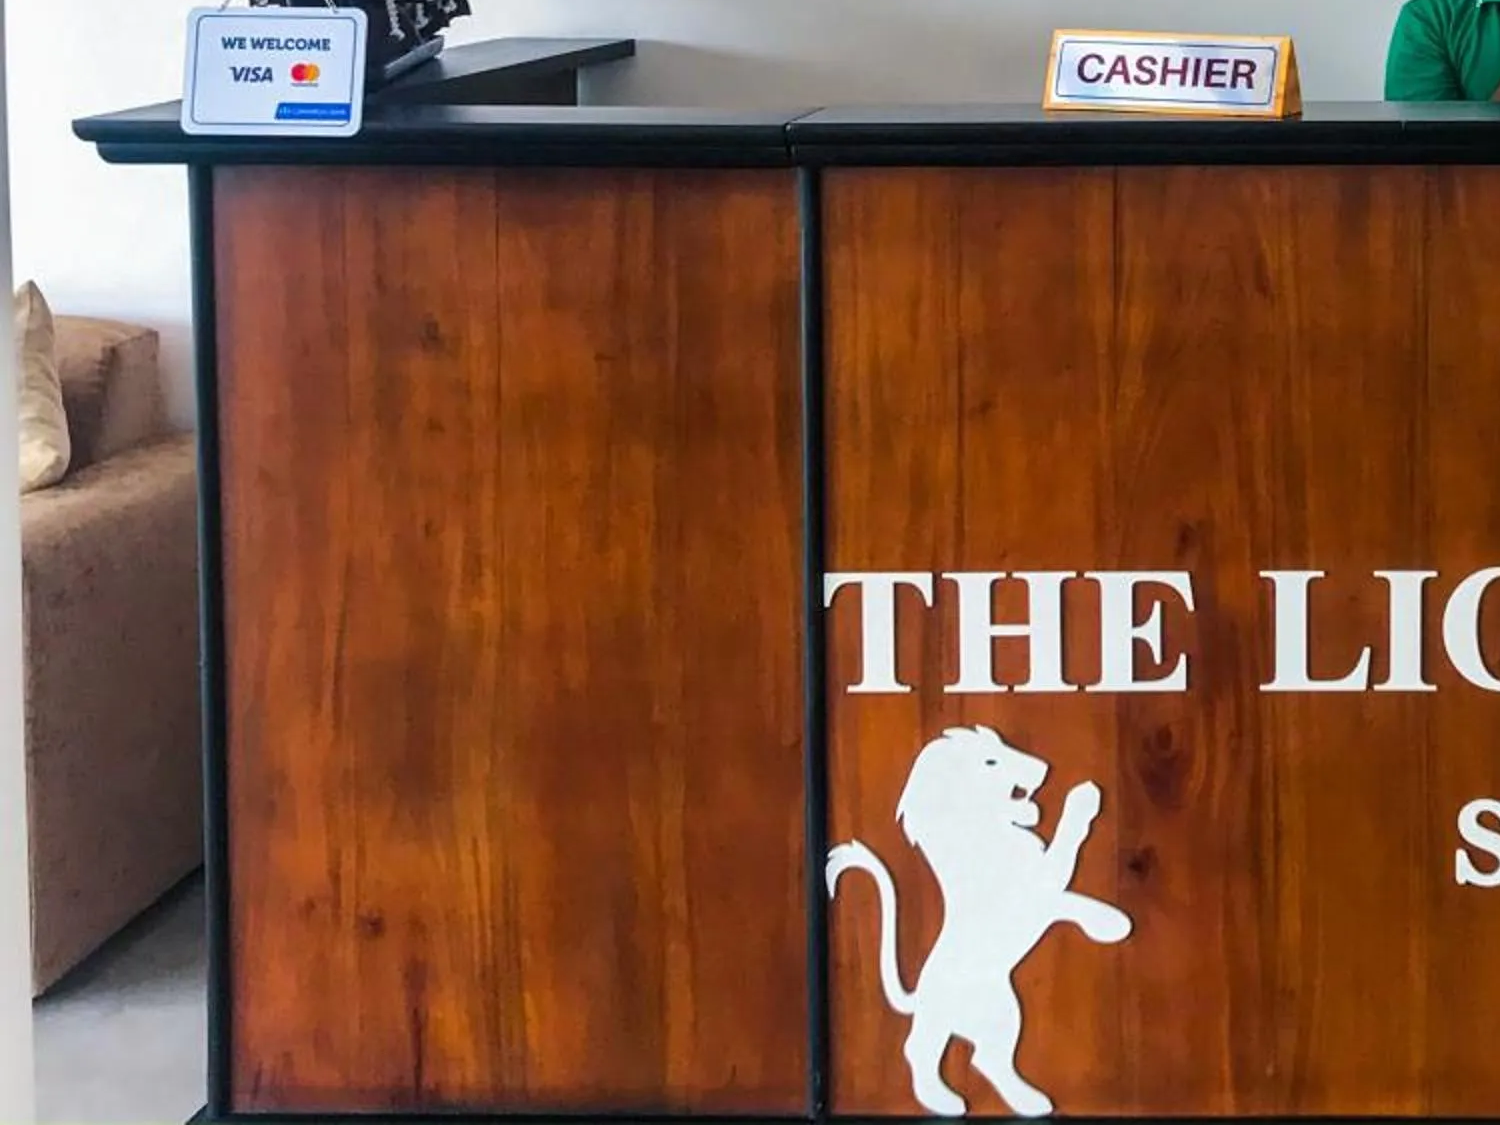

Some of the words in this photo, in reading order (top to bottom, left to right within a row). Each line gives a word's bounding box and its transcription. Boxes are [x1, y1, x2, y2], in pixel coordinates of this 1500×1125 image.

[221, 36, 247, 50] WE
[250, 37, 331, 52] WELCOME
[229, 66, 274, 83] VISA
[1077, 53, 1257, 90] CASHIER
[823, 570, 1195, 694] THE
